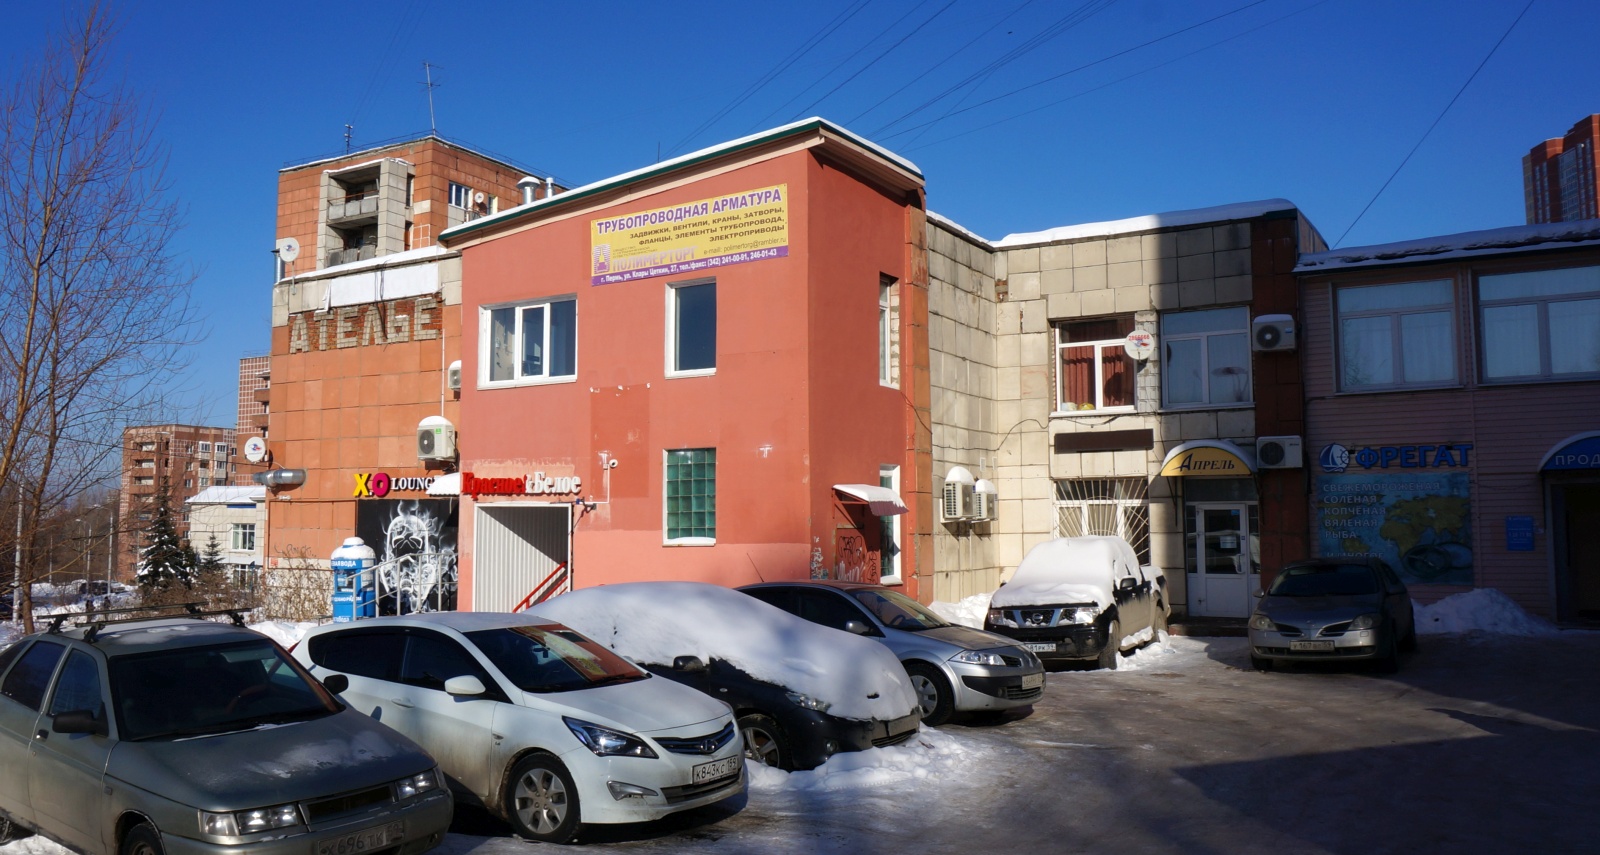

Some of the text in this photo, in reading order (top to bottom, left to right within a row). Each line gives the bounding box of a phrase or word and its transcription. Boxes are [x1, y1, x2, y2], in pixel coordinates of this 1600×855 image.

[597, 189, 782, 234] ТРУБОПРОВОДНАЯ АРМАТУРА
[630, 207, 785, 239] ЗАДВИЖКИ, ВЕНТИЛИ, КРАНЫ, ЗАТВОРЫ,
[638, 216, 785, 245] ФЛАНЦЫ, ЭЛЕМЕНТЫ ТРУБОПРОВОДА,
[709, 224, 785, 242] ЭЛЕКТРОПРИВОДЫ
[612, 245, 698, 272] ПОЛИМЕРТОРГ
[703, 237, 786, 255] e-mail: polimertorg@rambler.ru
[605, 274, 624, 283] Пермь,
[632, 269, 649, 279] Клары
[649, 266, 670, 277] Цеткин,
[670, 263, 679, 272] 27,
[707, 258, 721, 268] (342)
[721, 252, 750, 264] 241-00-91,
[750, 248, 777, 259] 246-01-43
[289, 297, 438, 354] АТЕЛЬЕ
[1355, 444, 1473, 469] ФРЕГАТ
[391, 477, 438, 490] LOUNG
[1323, 482, 1440, 492] СВЕЖЕМОРОЖЕНАЯ
[1325, 530, 1357, 539] РЫБА
